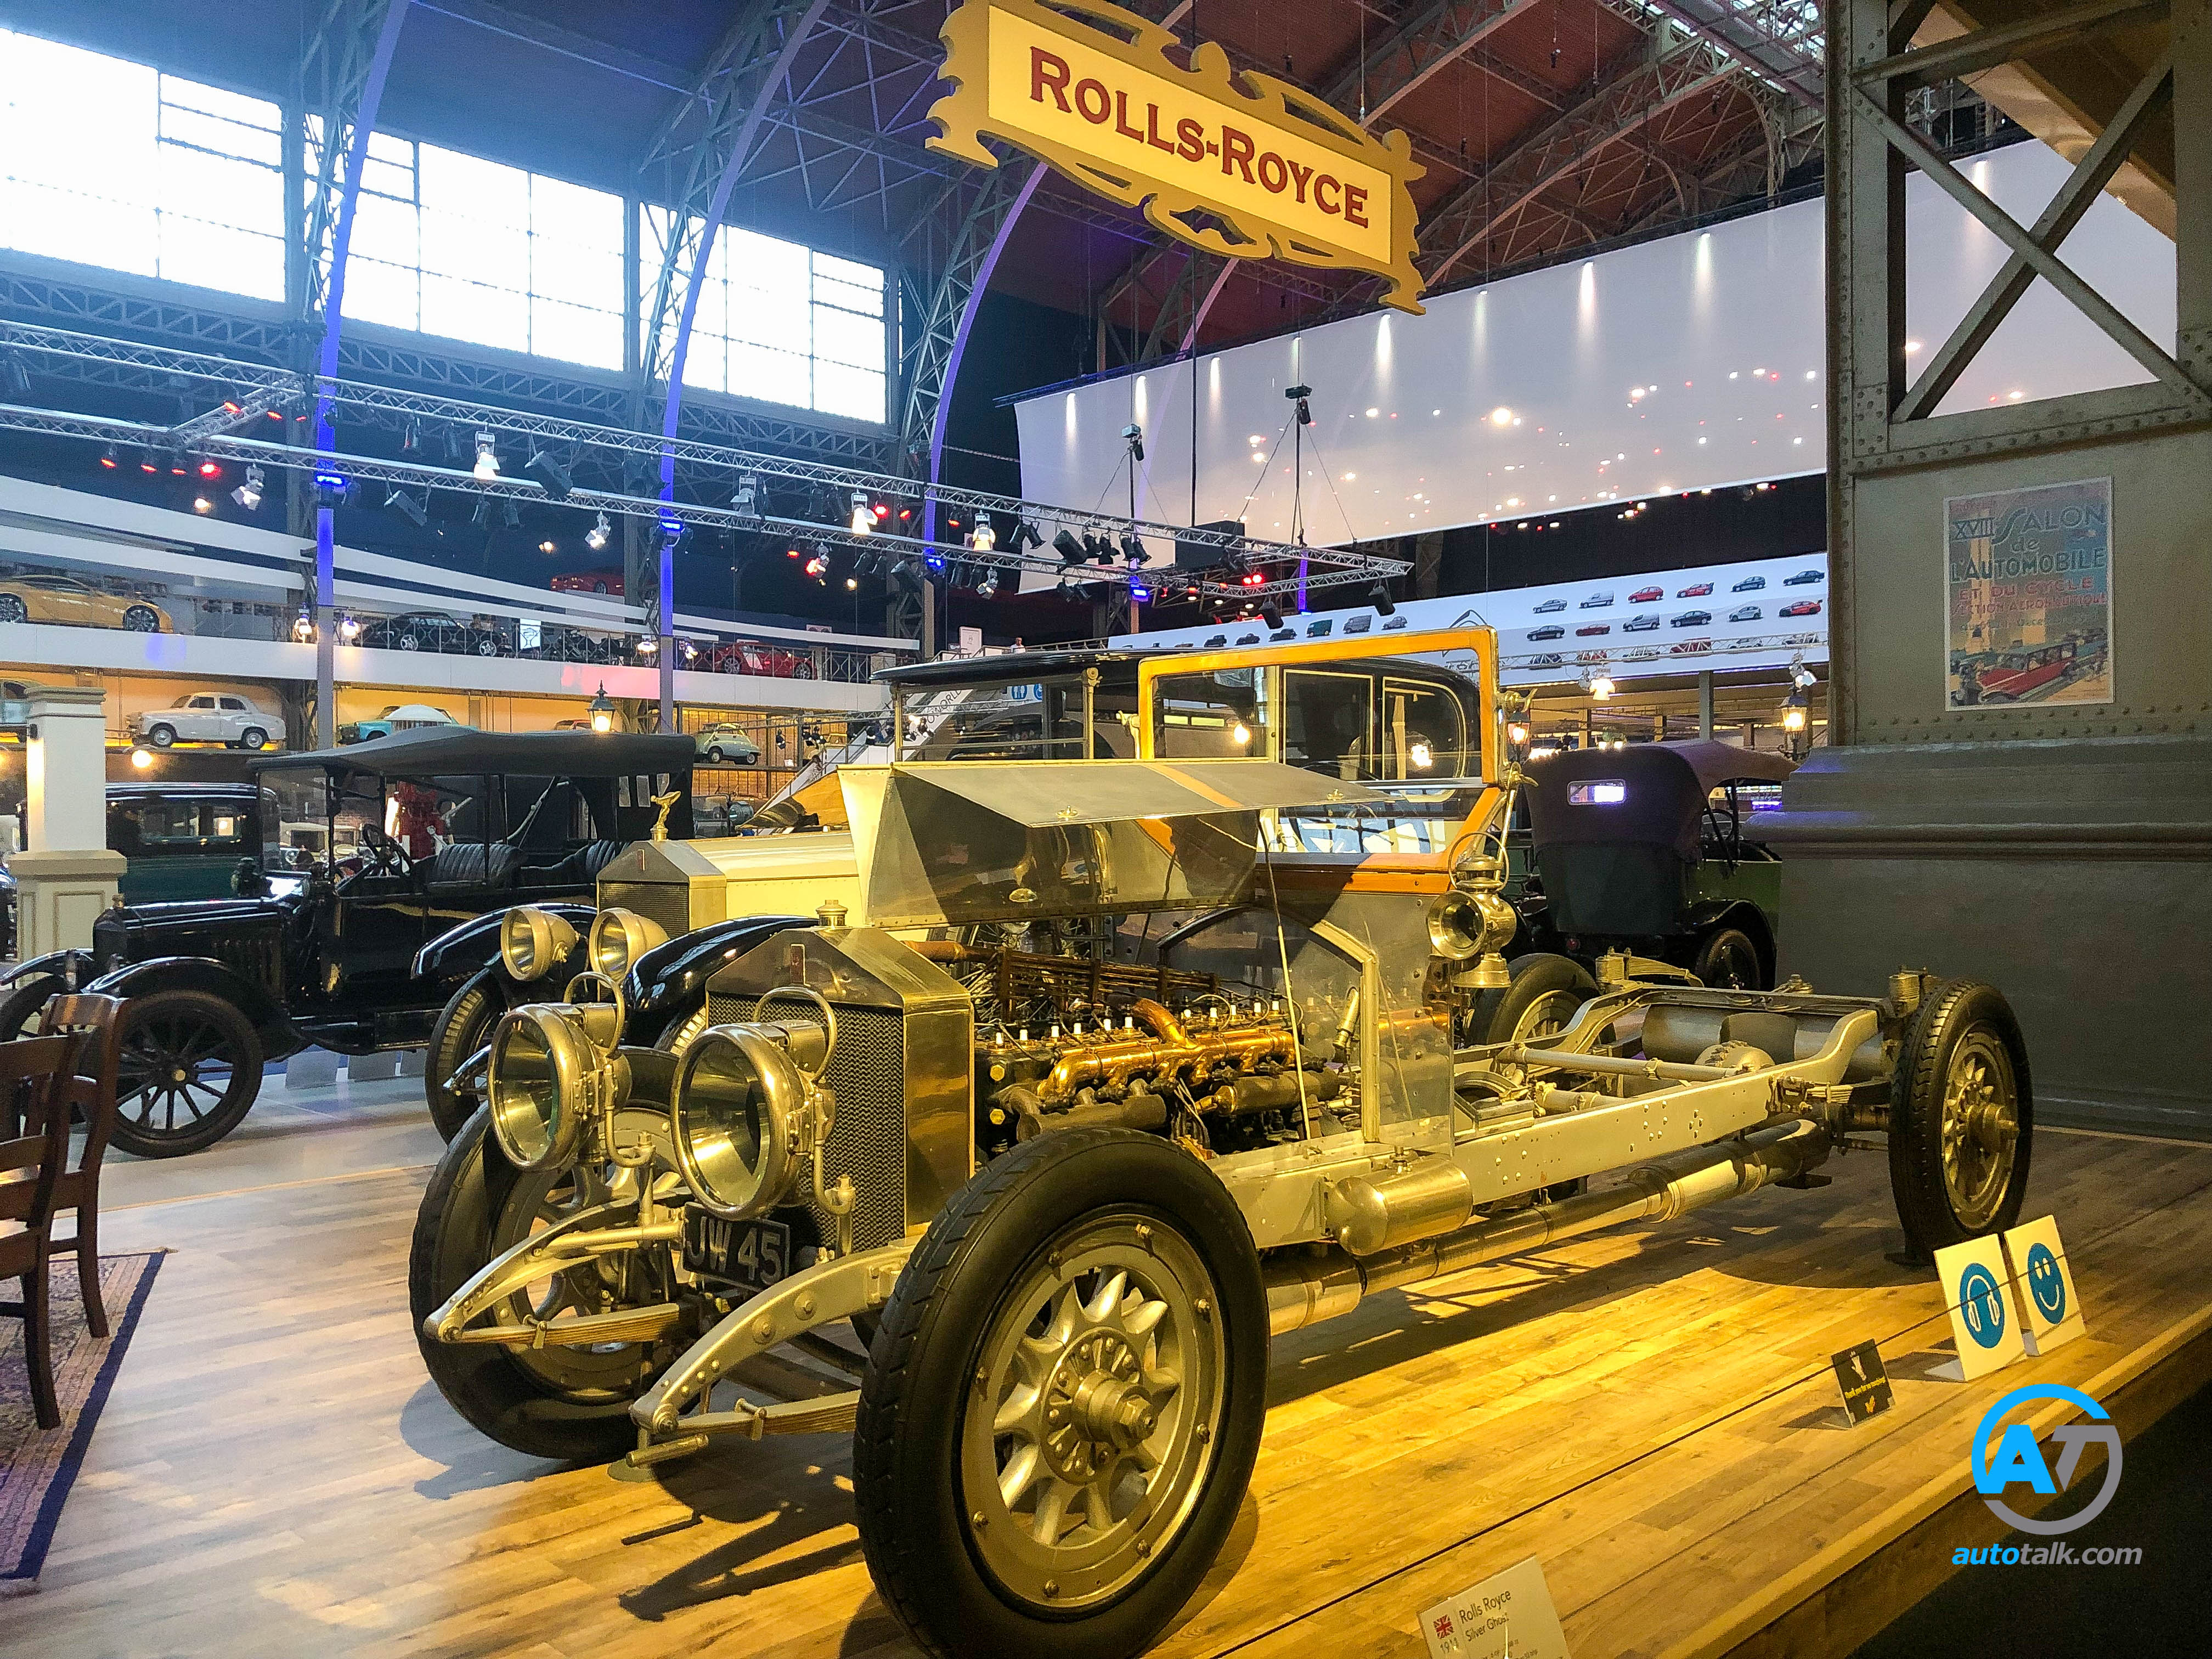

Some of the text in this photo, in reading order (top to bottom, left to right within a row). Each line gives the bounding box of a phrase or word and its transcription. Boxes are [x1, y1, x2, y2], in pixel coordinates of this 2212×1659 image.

[1029, 46, 1369, 229] ROLLS-ROYCE
[1991, 503, 2106, 545] SALON
[2011, 536, 2040, 552] de
[1960, 577, 2093, 600] ET DU CYCLE
[738, 1227, 783, 1285] 45
[1459, 1590, 1511, 1624] Rolls Royce
[1465, 1625, 1486, 1642] Silver
